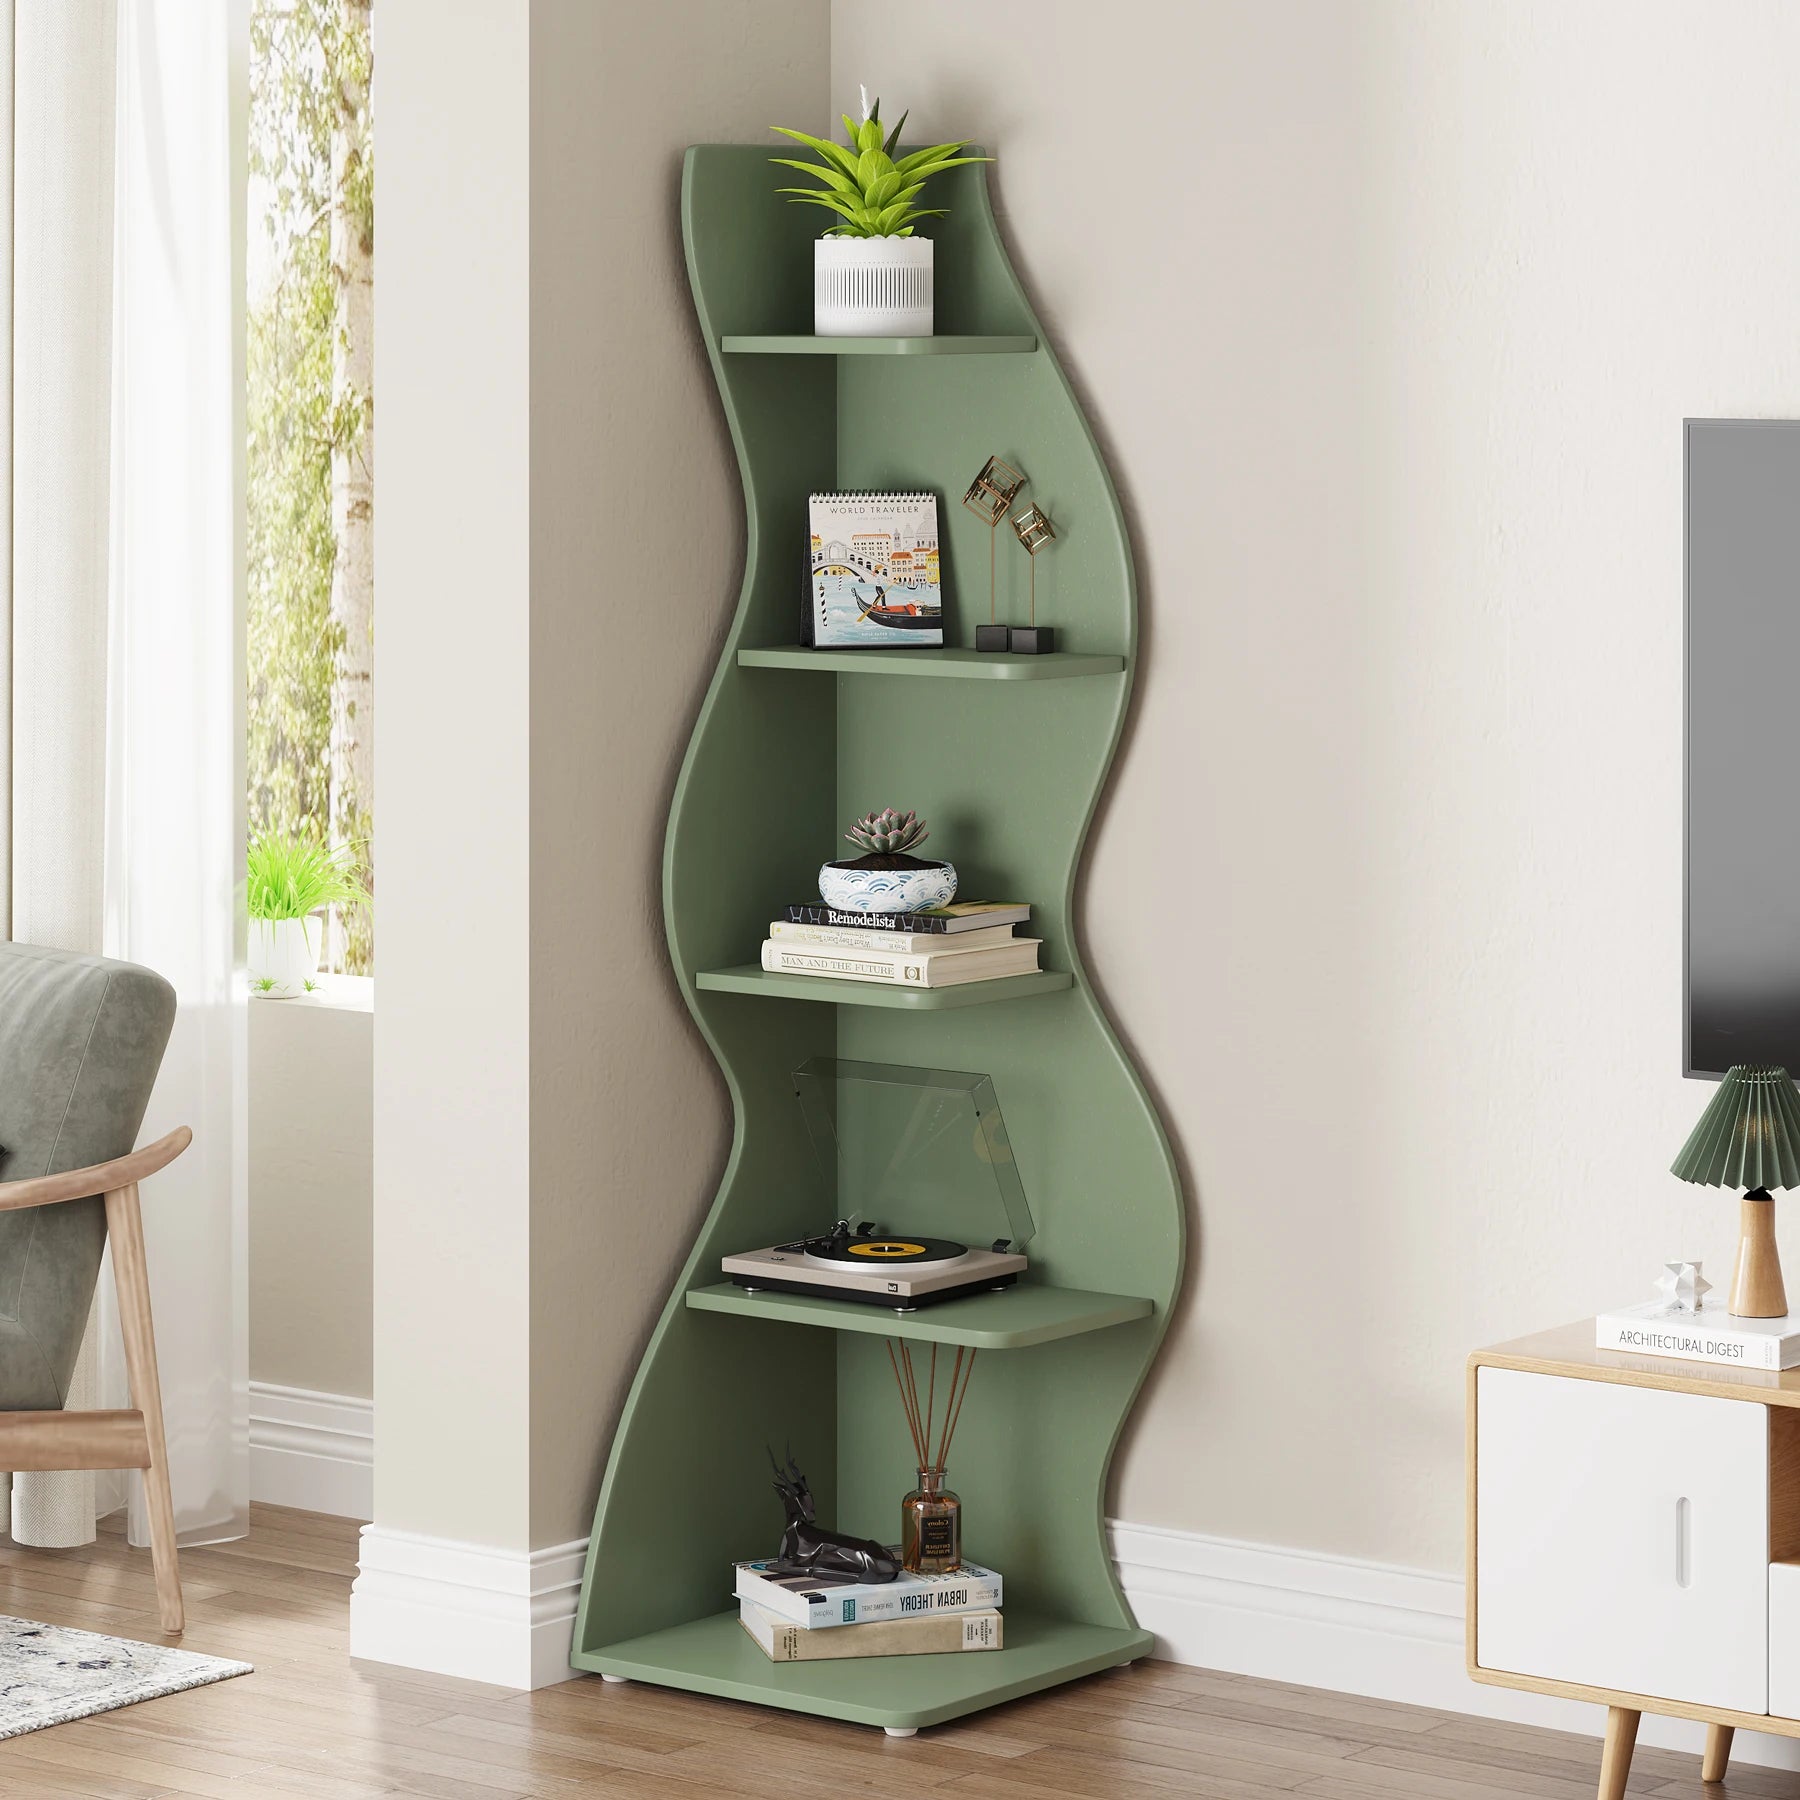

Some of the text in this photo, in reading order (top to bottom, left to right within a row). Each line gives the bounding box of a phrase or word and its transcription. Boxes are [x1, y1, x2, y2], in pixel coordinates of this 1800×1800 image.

[828, 910, 896, 928] Remodelista
[838, 934, 854, 946] They
[854, 938, 871, 949] What
[781, 956, 806, 967] MAN
[807, 958, 828, 968] AND
[830, 960, 851, 970] THE
[855, 964, 895, 975] FUTURE
[1619, 1330, 1704, 1354] ARCHITECTURAL
[1706, 1341, 1745, 1358] DIGEST
